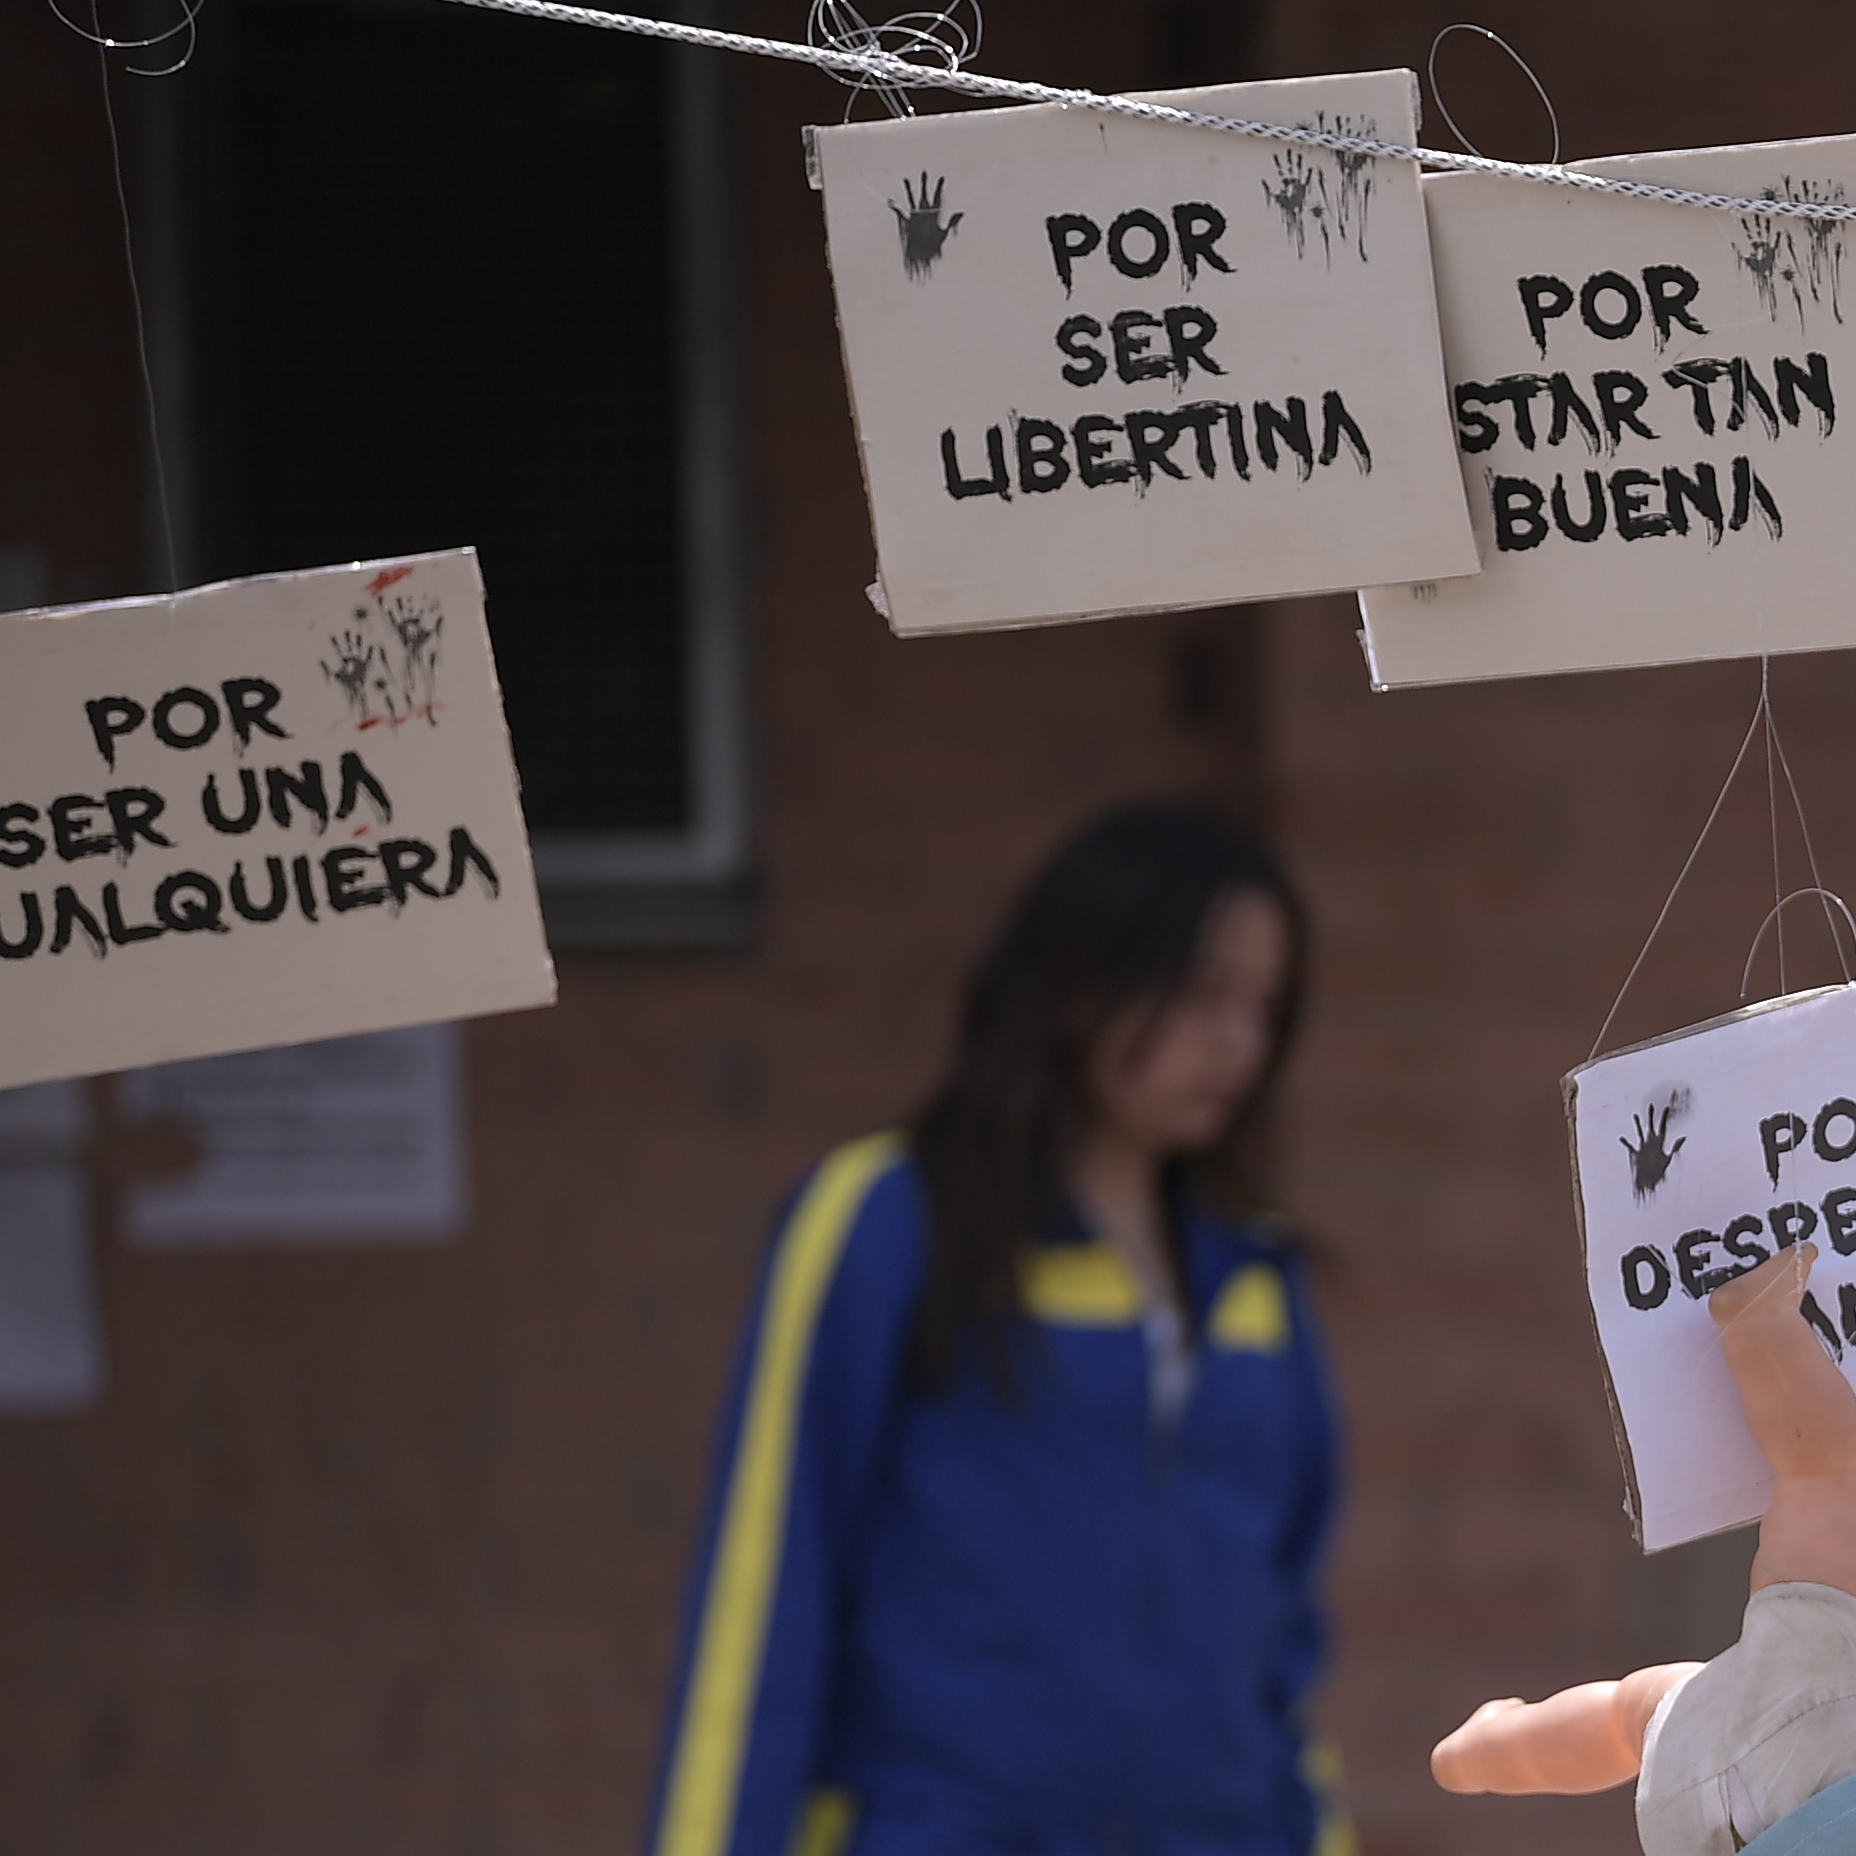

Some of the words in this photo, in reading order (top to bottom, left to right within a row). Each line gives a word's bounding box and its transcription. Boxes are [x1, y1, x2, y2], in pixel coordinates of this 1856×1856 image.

[1045, 201, 1238, 300] POR
[1055, 305, 1228, 395] SER
[1517, 263, 1711, 361] POR
[939, 388, 1373, 503] LIBERTINA
[1455, 370, 1662, 460] STAR
[1661, 351, 1836, 440] TAN
[1483, 455, 1783, 553] BUENA
[84, 676, 294, 774] POR
[0, 786, 180, 868] SER
[202, 750, 392, 836] UNA
[0, 827, 499, 960] UALQUIERA
